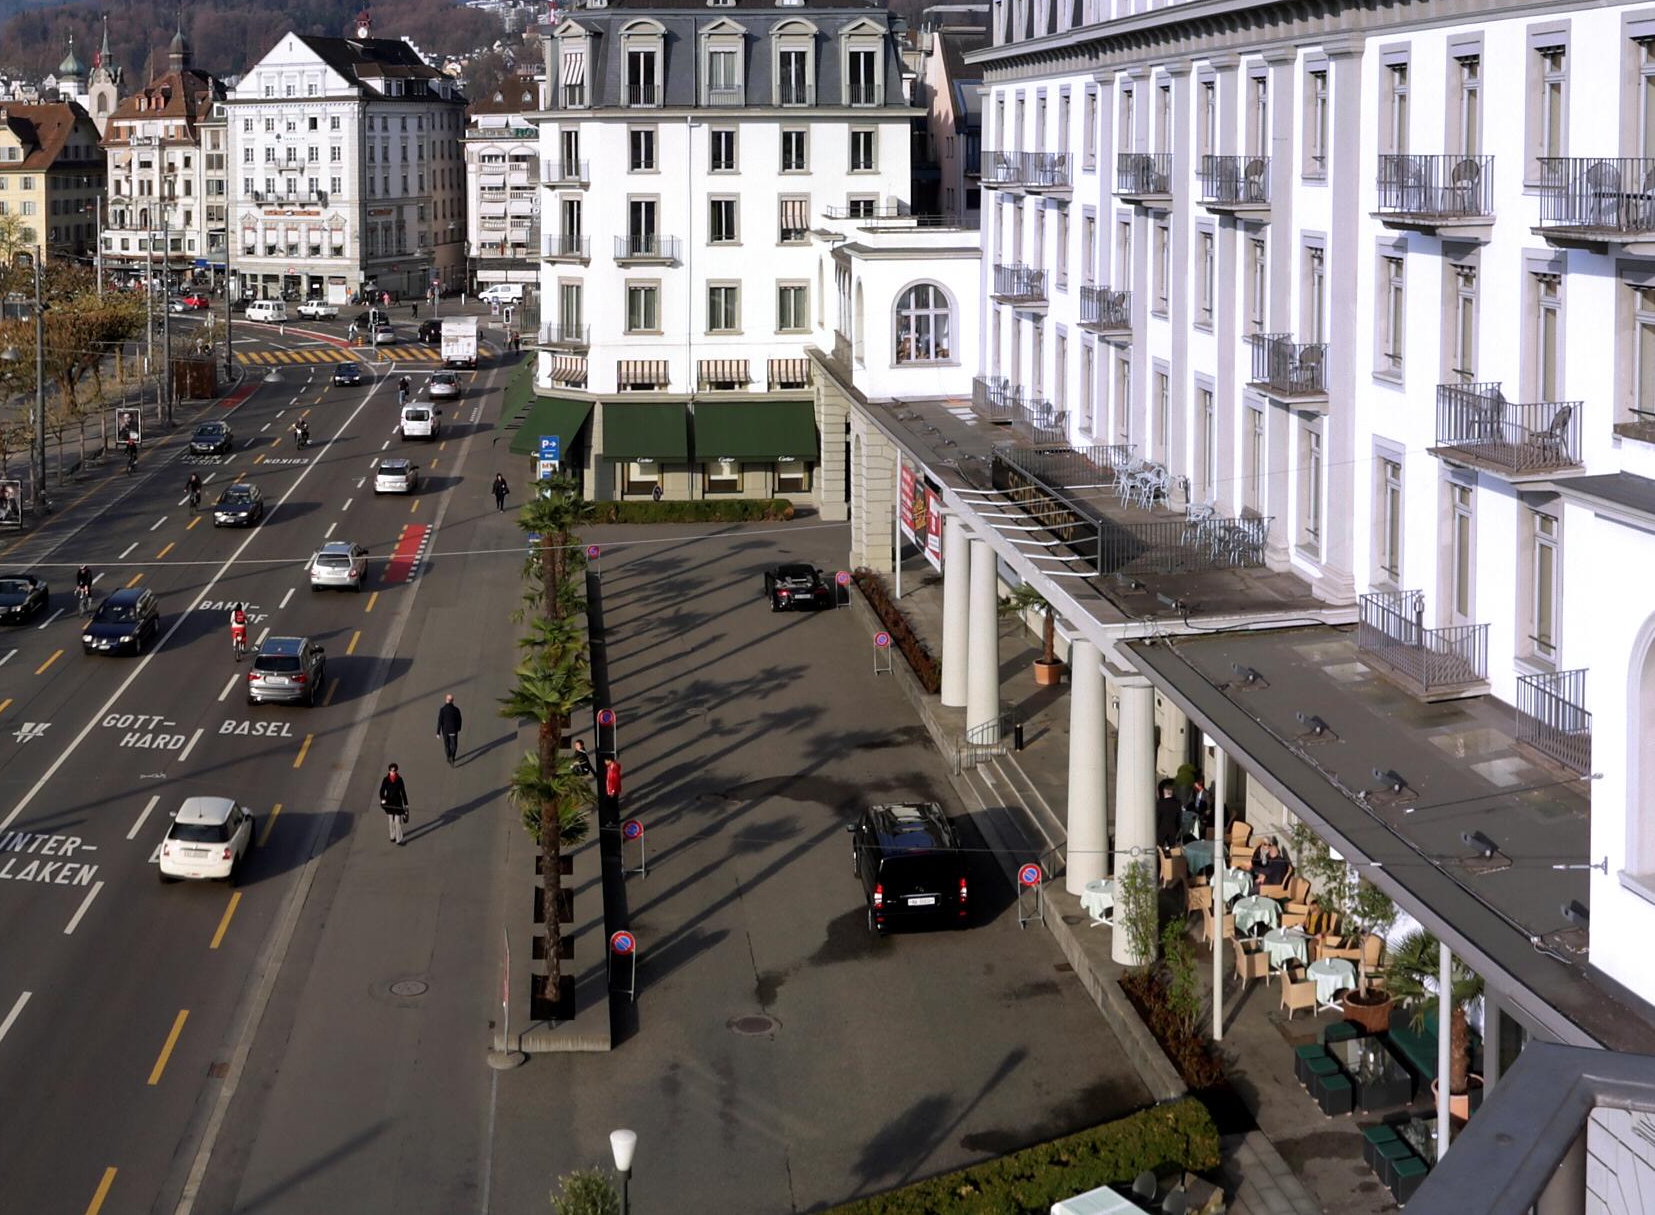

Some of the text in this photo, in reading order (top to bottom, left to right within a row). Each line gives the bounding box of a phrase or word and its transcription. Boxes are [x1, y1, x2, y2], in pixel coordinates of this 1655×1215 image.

[246, 613, 269, 624] OF
[103, 713, 176, 729] GOTT-
[218, 719, 293, 737] BASEL
[120, 732, 186, 750] HARD
